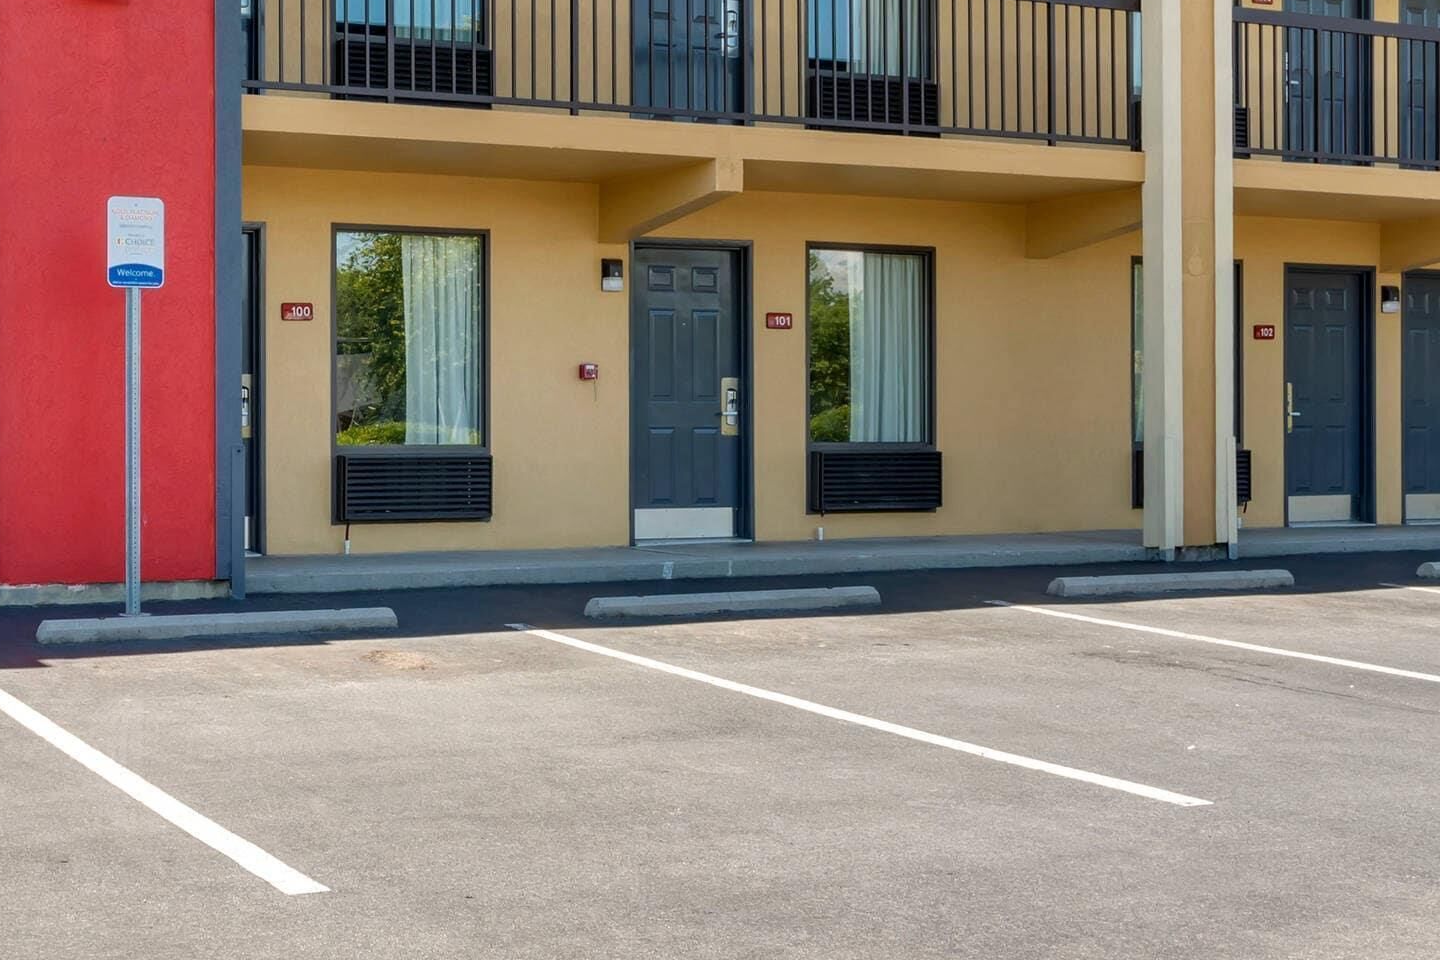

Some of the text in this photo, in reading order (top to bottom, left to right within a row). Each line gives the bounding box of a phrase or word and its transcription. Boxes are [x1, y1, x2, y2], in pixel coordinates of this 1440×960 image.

[291, 305, 311, 317] 100
[774, 315, 791, 326] 101
[1260, 327, 1274, 337] 102
